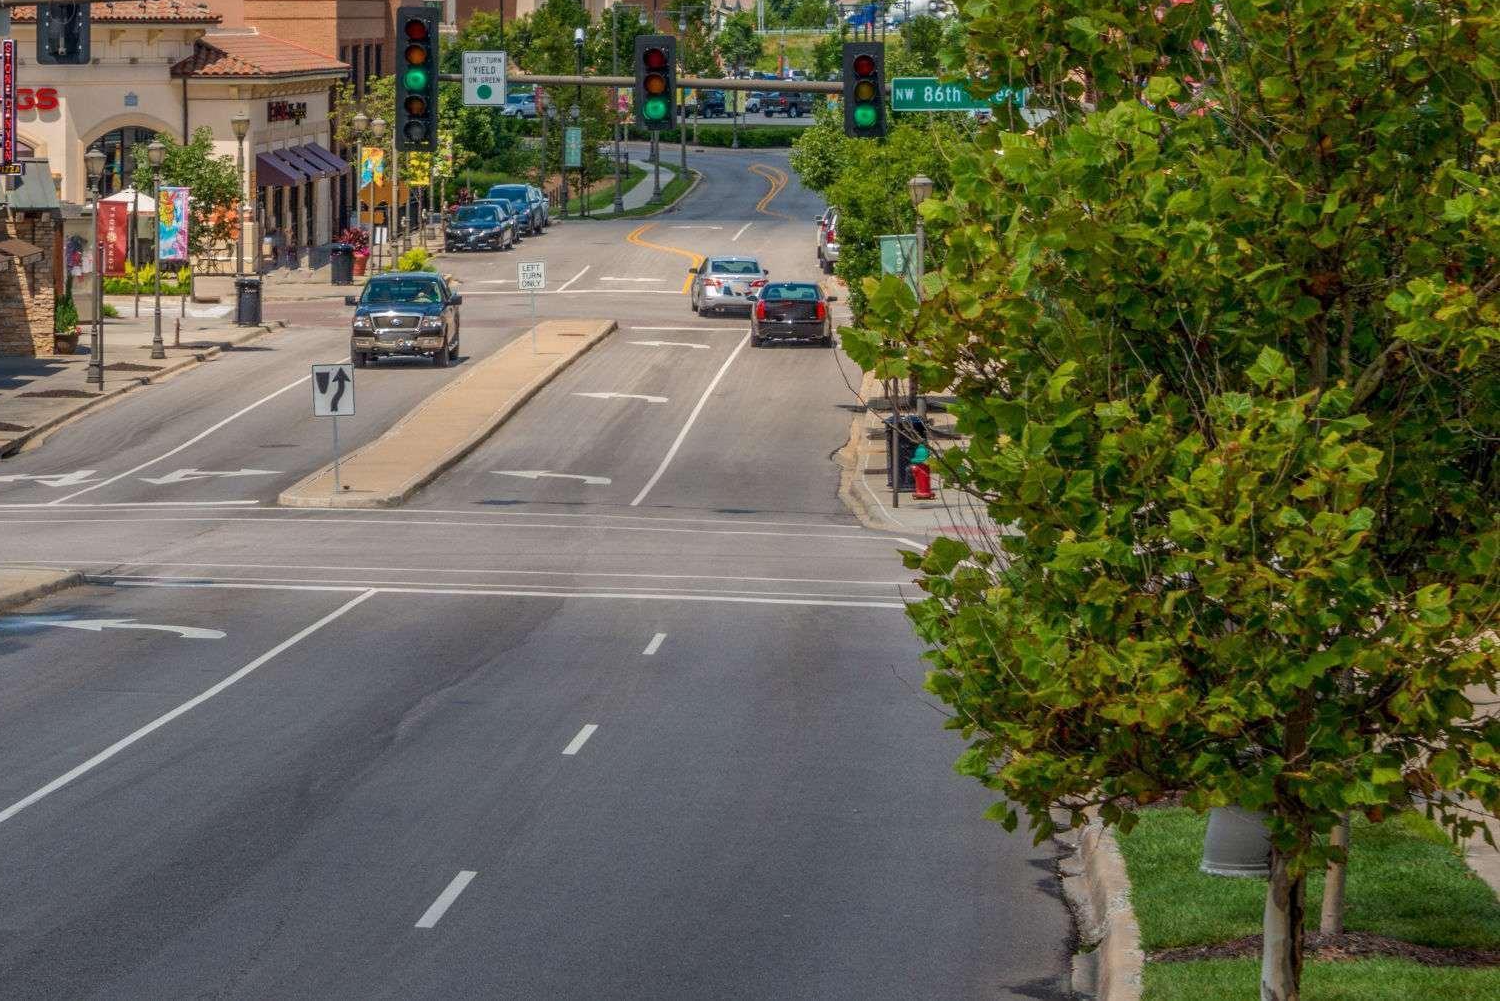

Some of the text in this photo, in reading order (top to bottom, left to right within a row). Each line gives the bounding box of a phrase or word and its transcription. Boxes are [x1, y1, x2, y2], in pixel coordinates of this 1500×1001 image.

[467, 56, 502, 64] LEFT TURN
[473, 66, 496, 75] YIELD
[895, 88, 915, 101] NW
[923, 85, 962, 103] 86th
[522, 279, 541, 287] ONLY
